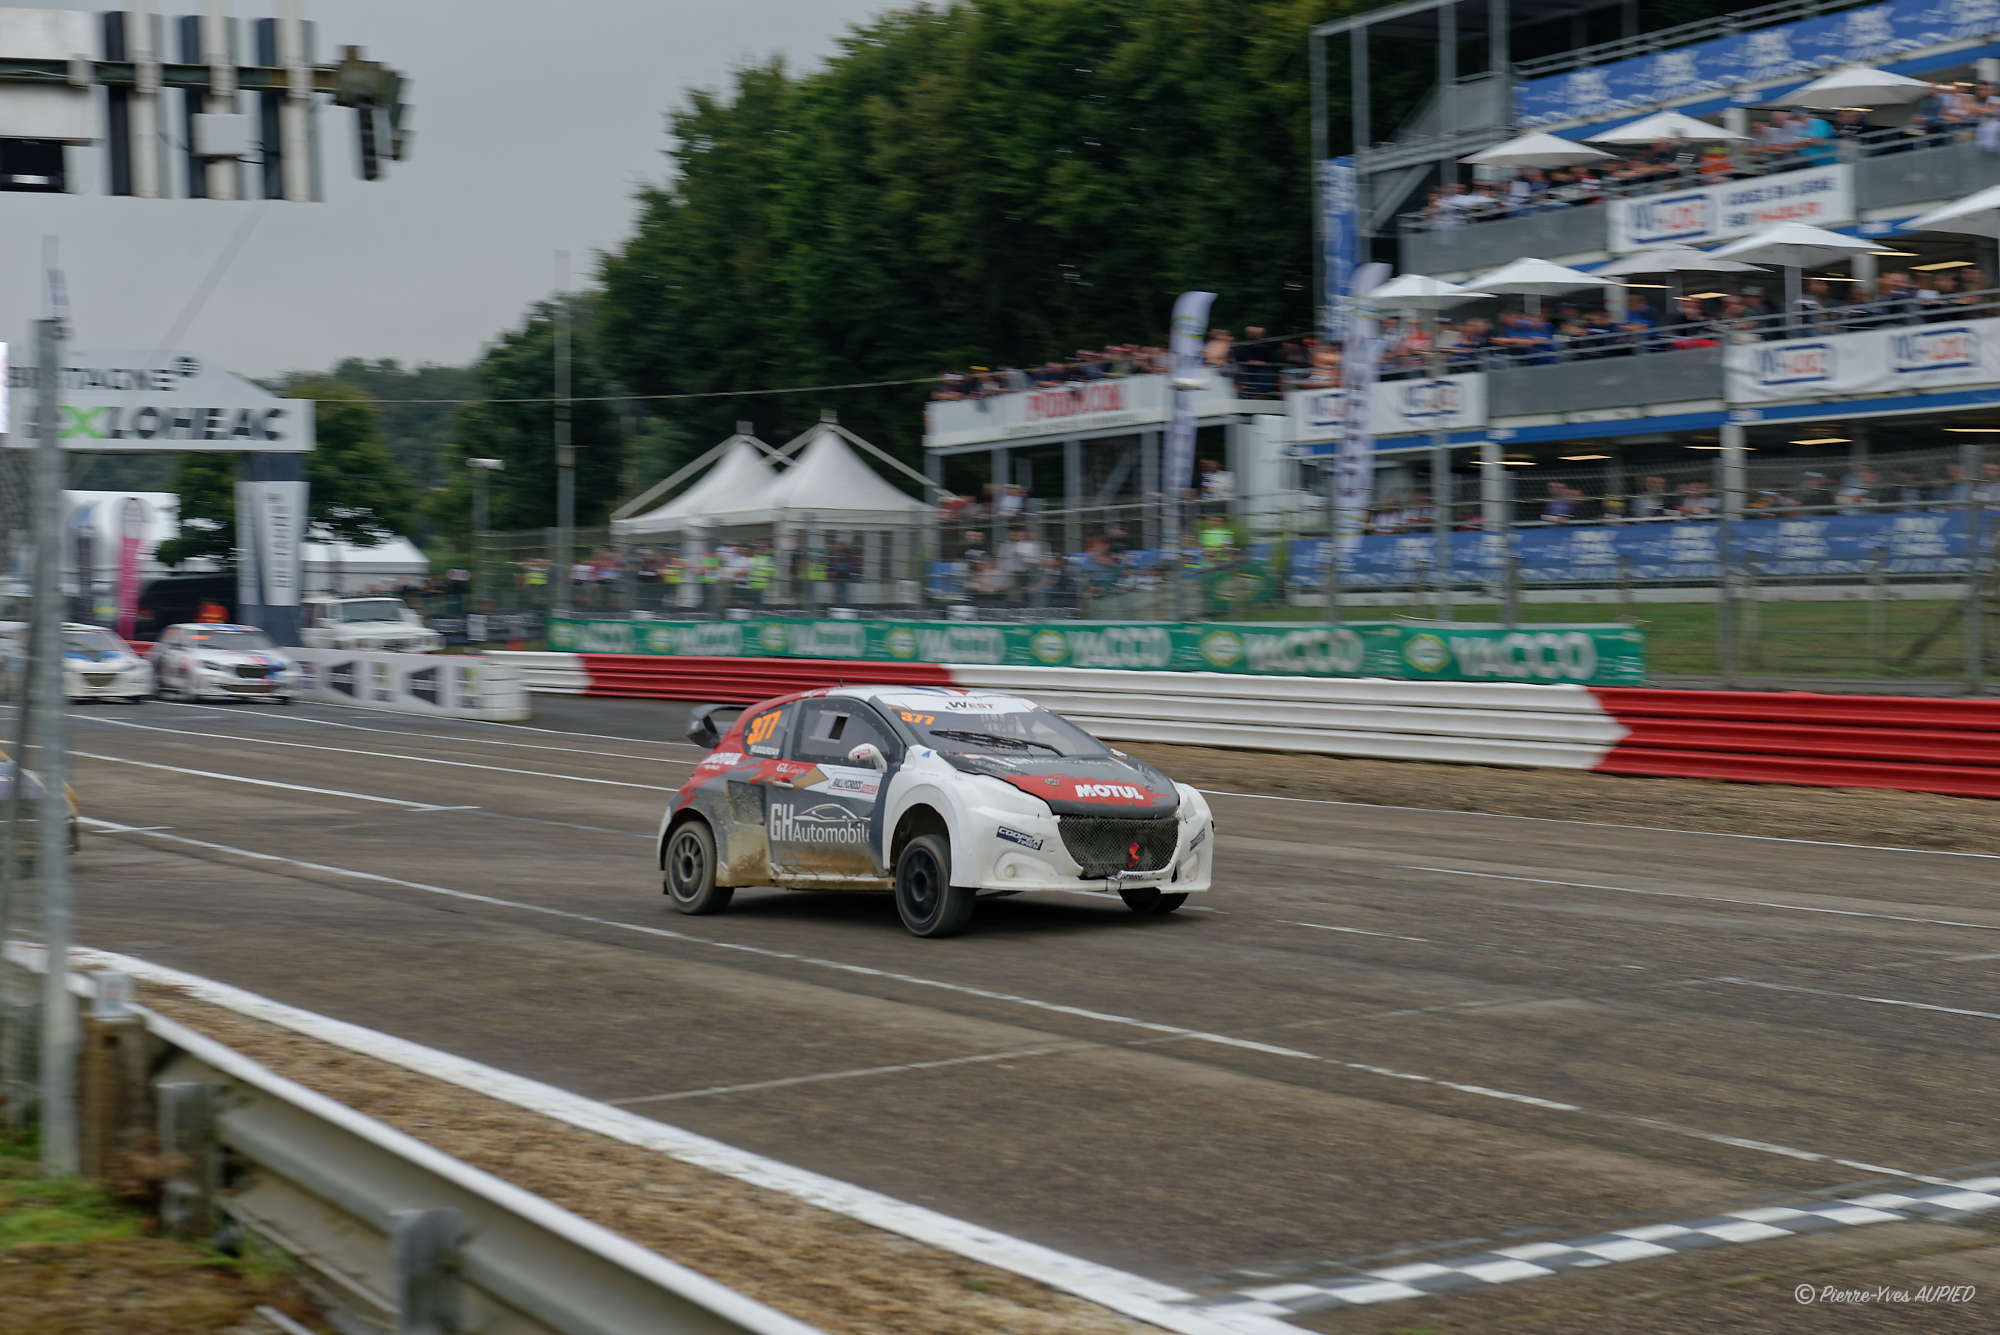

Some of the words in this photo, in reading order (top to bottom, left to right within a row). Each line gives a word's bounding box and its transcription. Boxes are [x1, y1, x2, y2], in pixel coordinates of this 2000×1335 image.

[107, 405, 290, 440] LOHEAC
[1449, 632, 1597, 681] YACCO
[900, 711, 936, 726] 377
[946, 701, 994, 711] WEST
[746, 710, 782, 745] 377
[1075, 784, 1145, 800] MOTUL
[770, 803, 795, 842] GH
